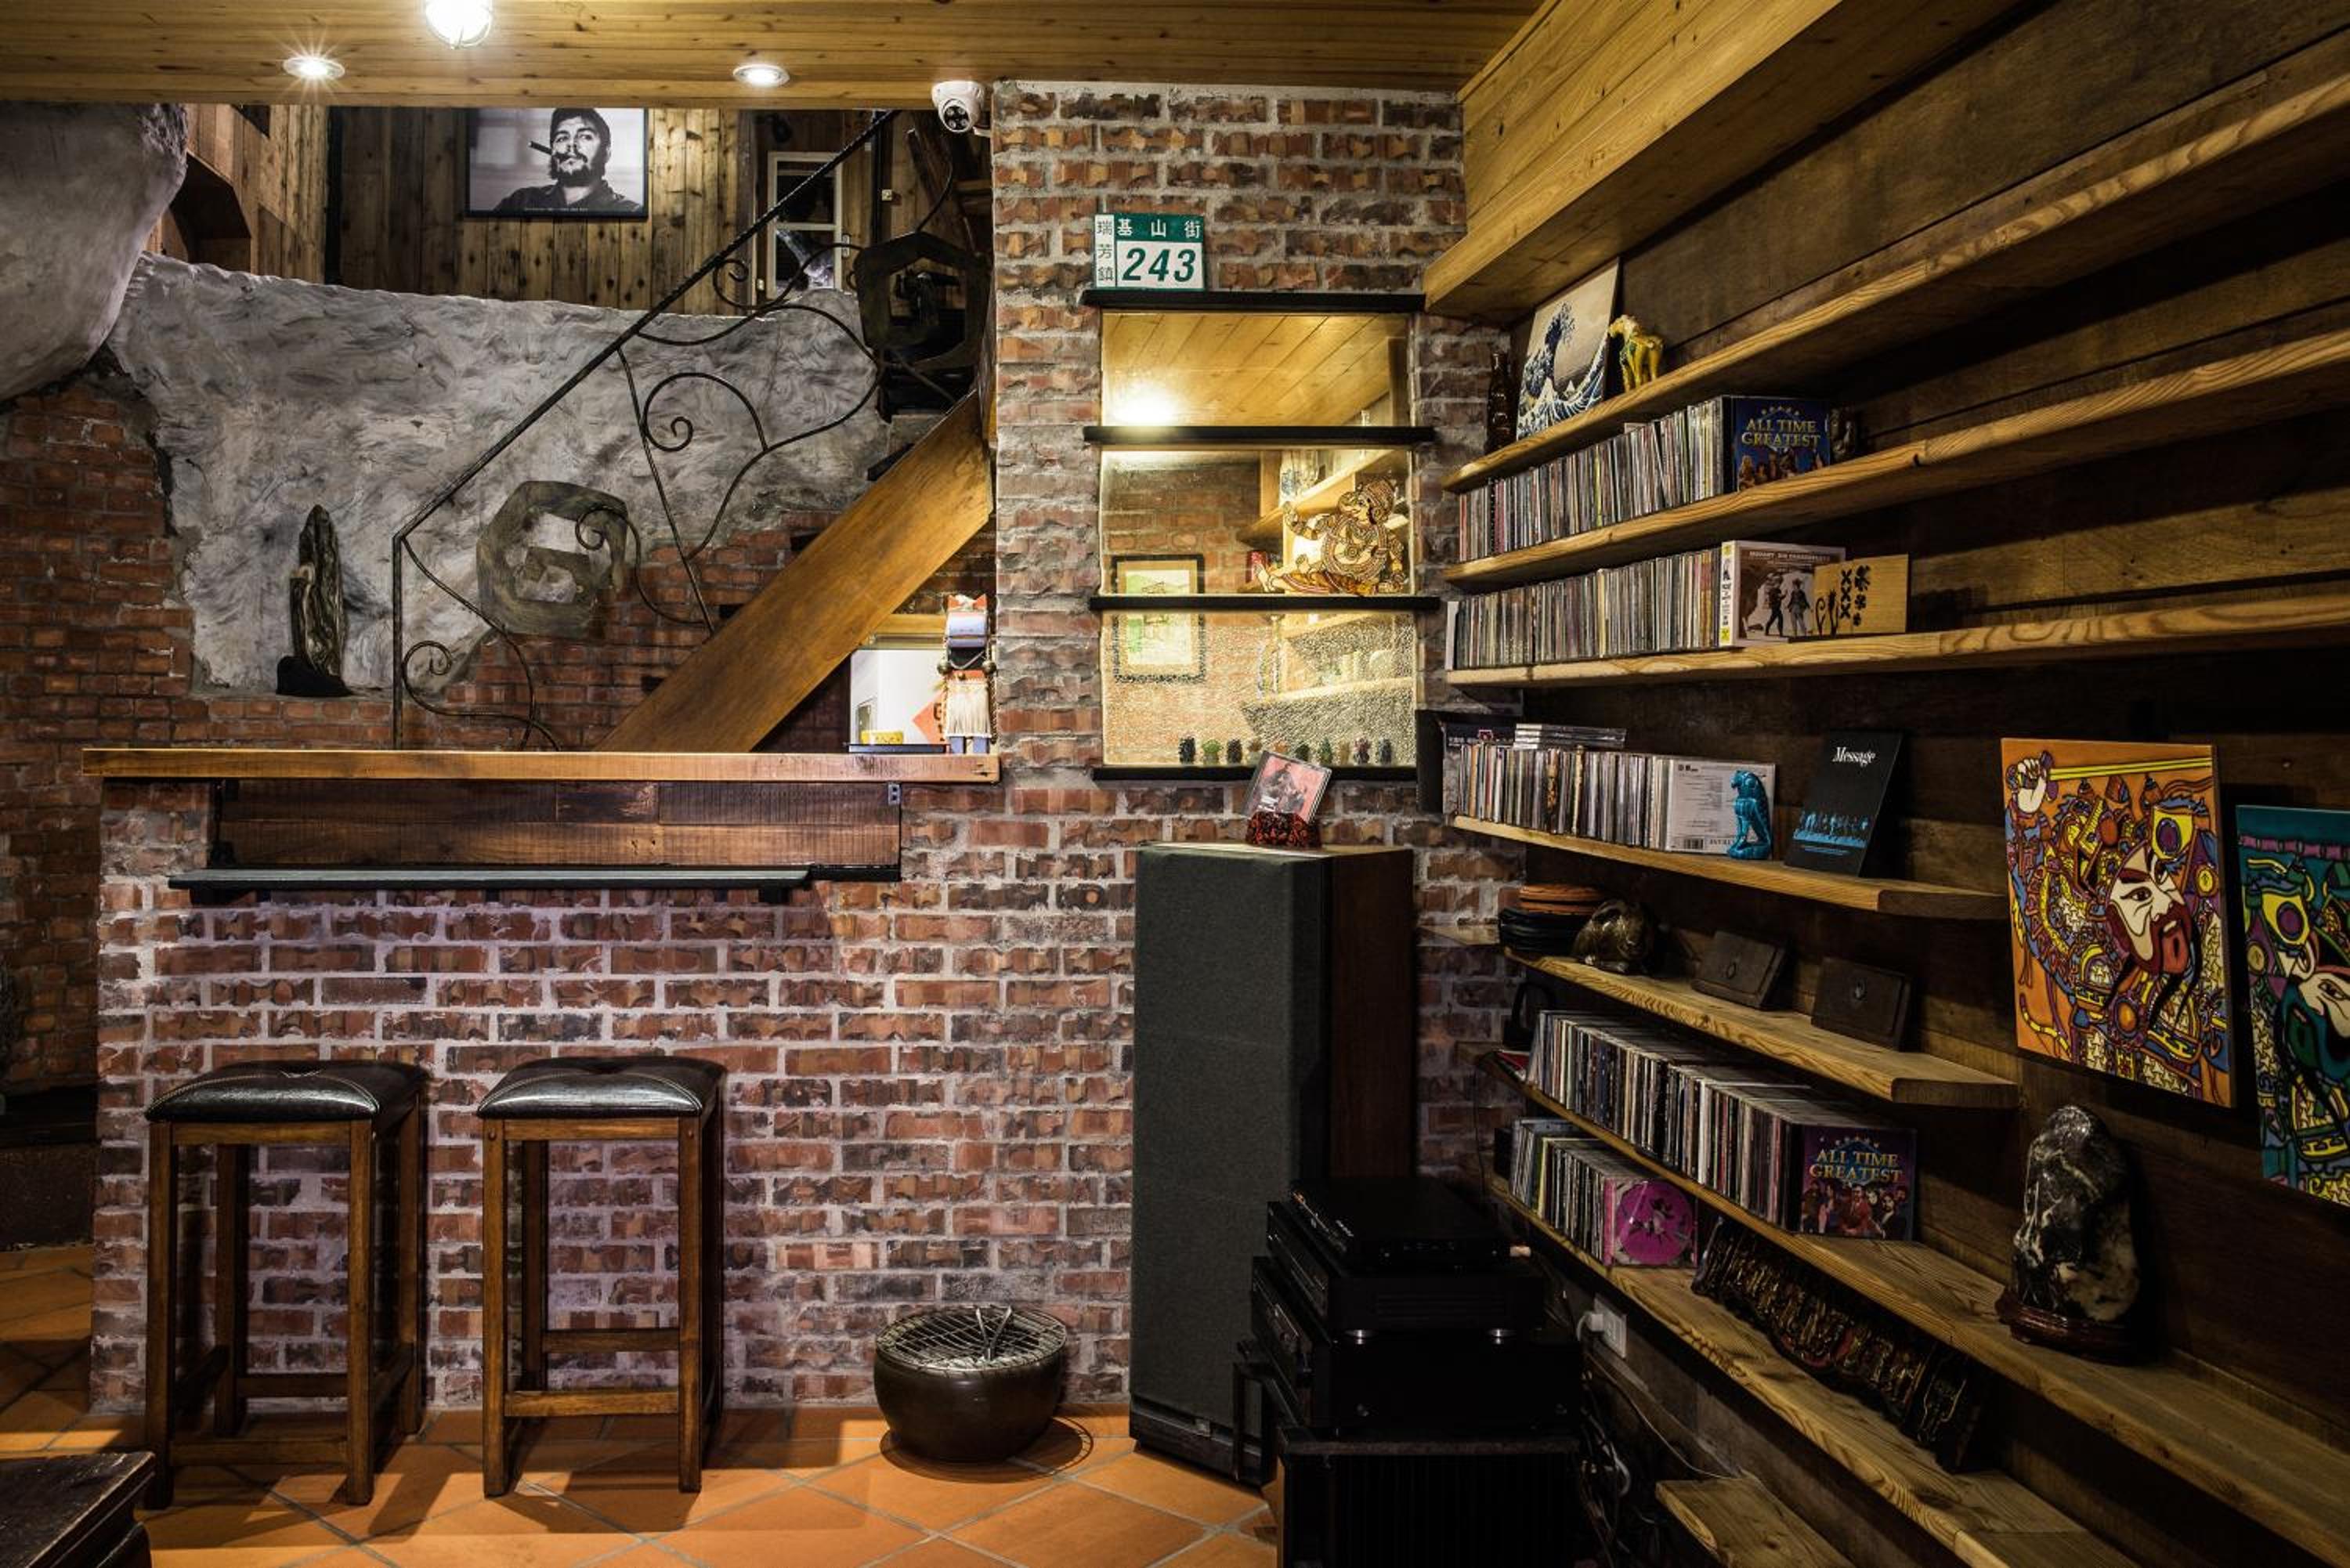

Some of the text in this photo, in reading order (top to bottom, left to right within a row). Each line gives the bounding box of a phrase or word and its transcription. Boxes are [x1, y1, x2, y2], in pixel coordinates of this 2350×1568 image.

[1117, 219, 1201, 239] 基山街
[1096, 220, 1113, 281] 瑞芳鎮
[1122, 247, 1196, 282] 243
[1746, 418, 1817, 433] ALL TIME
[1741, 432, 1821, 446] GREATEST
[1832, 746, 1876, 767] Message
[1817, 1148, 1898, 1166] ALL TIME
[1809, 1164, 1904, 1182] GREATEST
